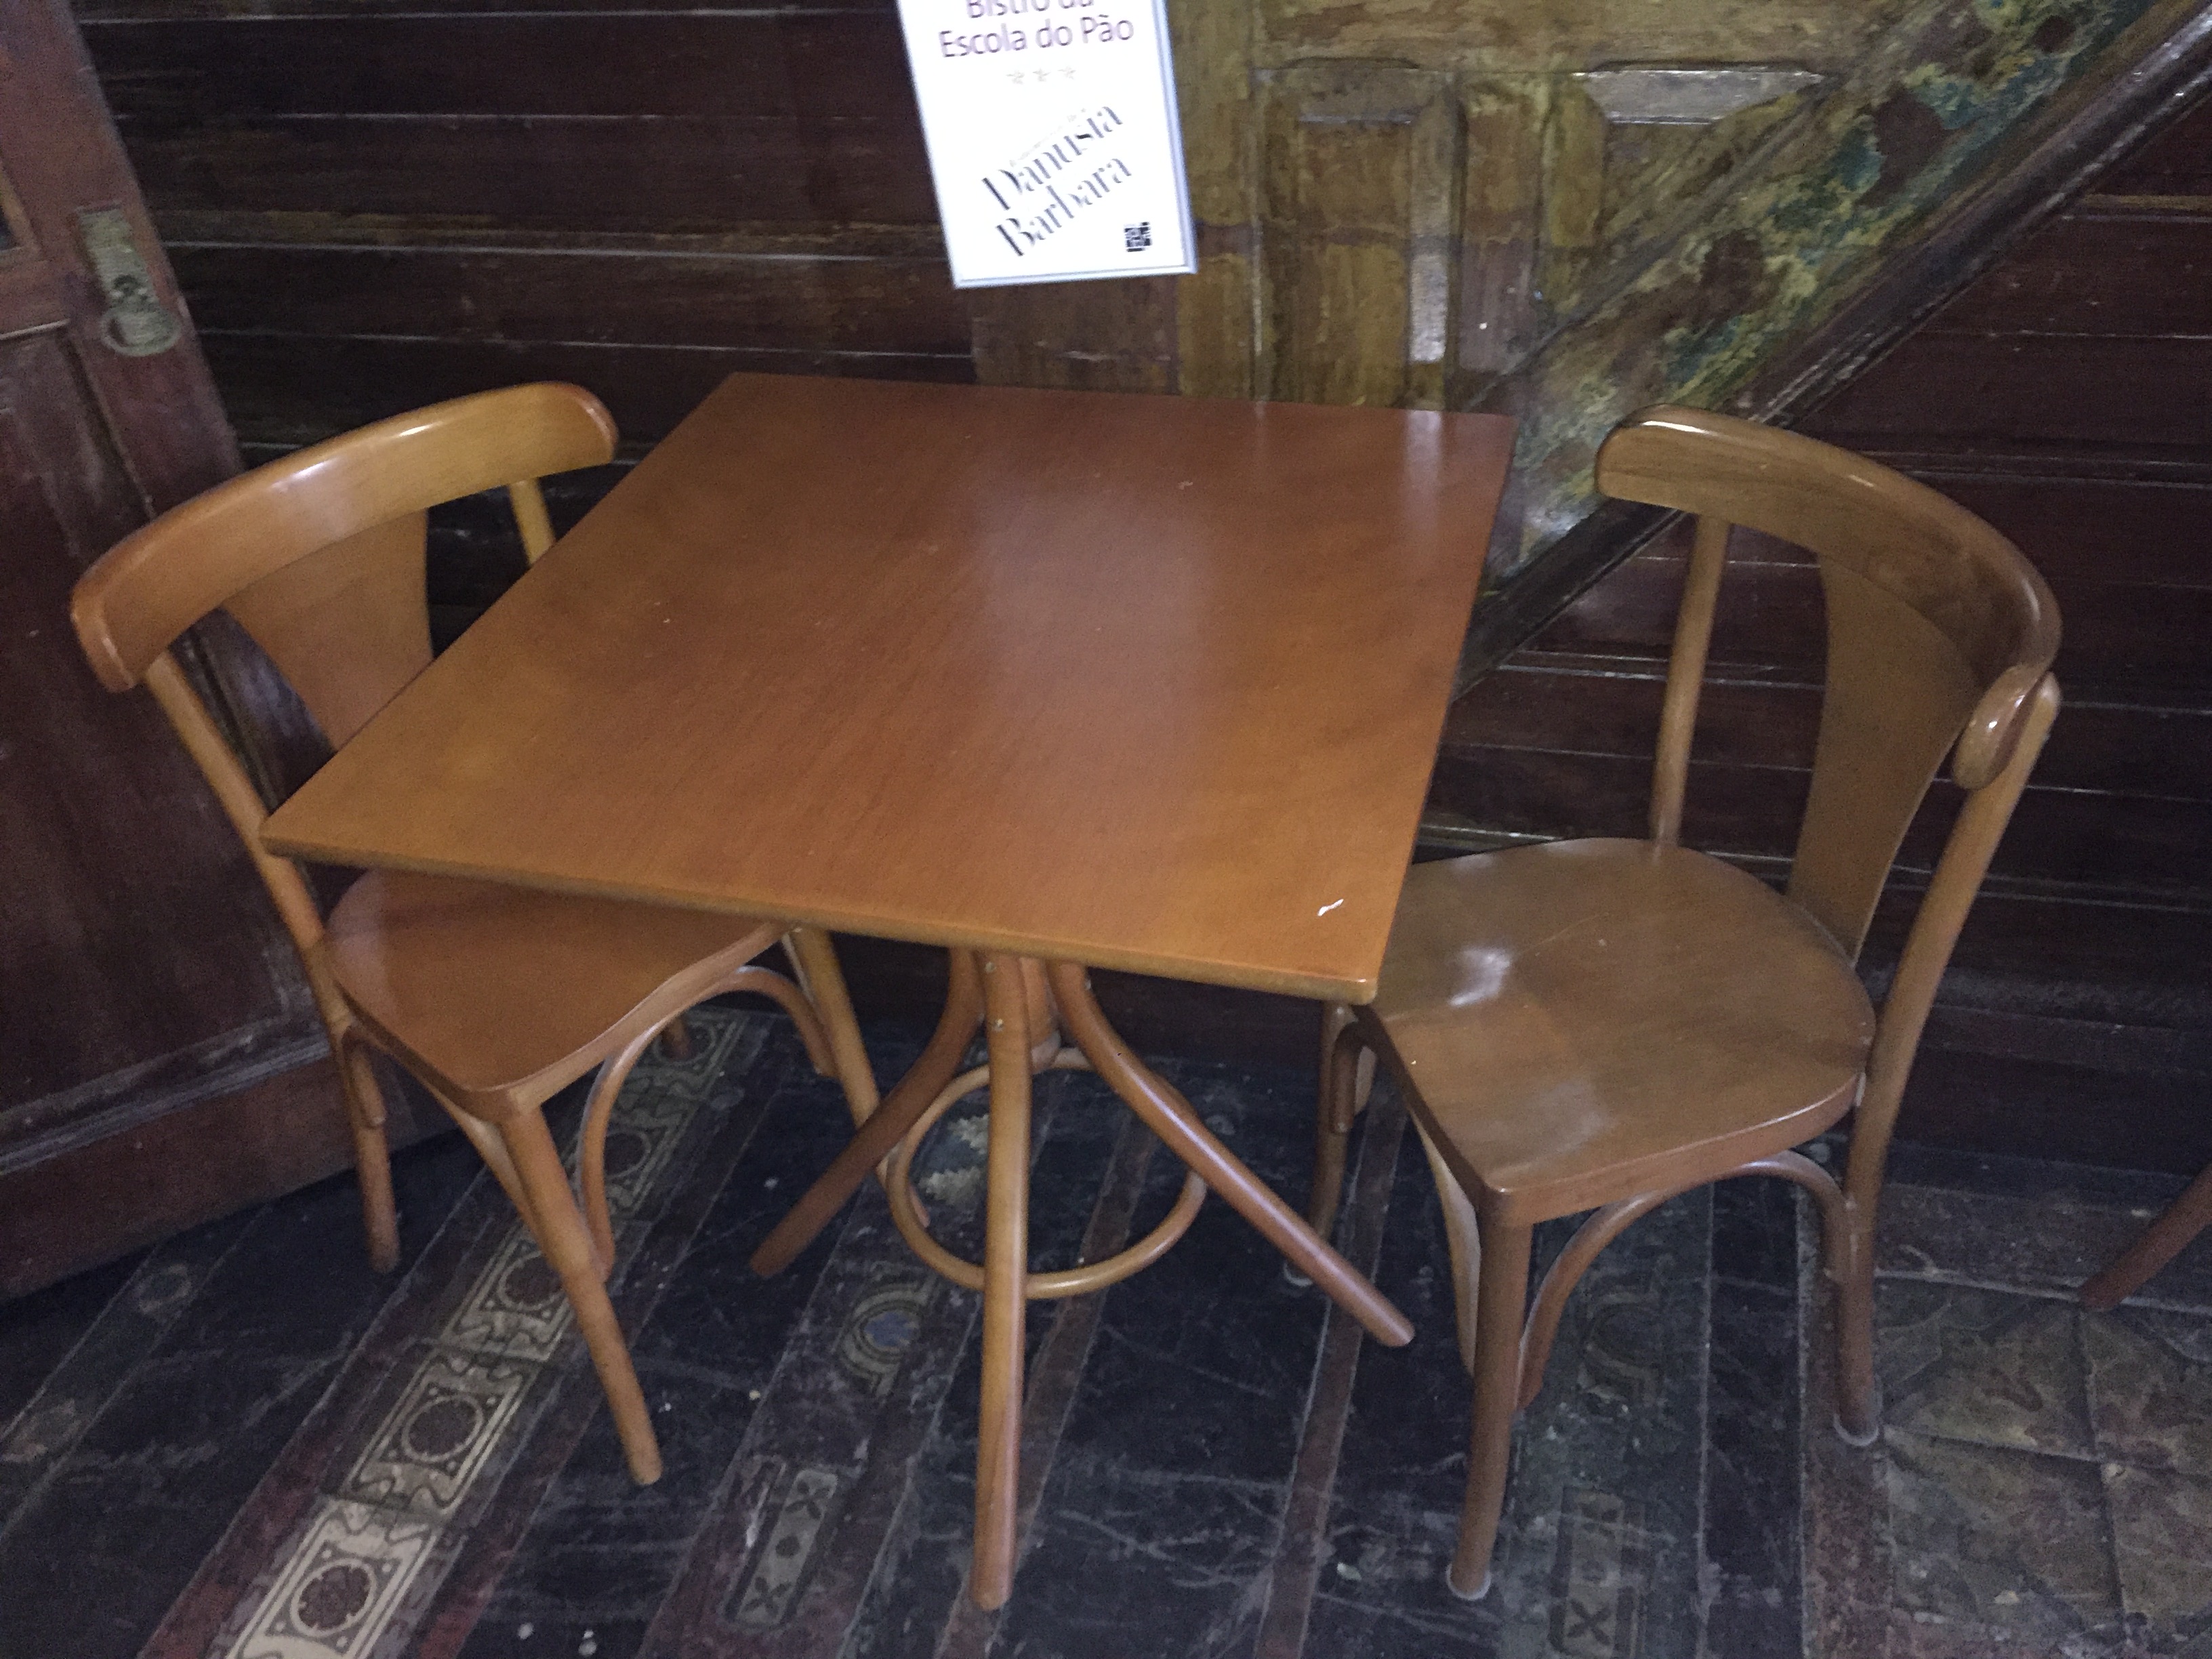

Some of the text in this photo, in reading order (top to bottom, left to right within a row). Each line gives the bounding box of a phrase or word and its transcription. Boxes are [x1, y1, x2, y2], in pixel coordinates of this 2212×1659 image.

[939, 14, 1134, 57] Escola do Pão
[980, 106, 1123, 211] Danusia
[994, 157, 1132, 257] Barbara
